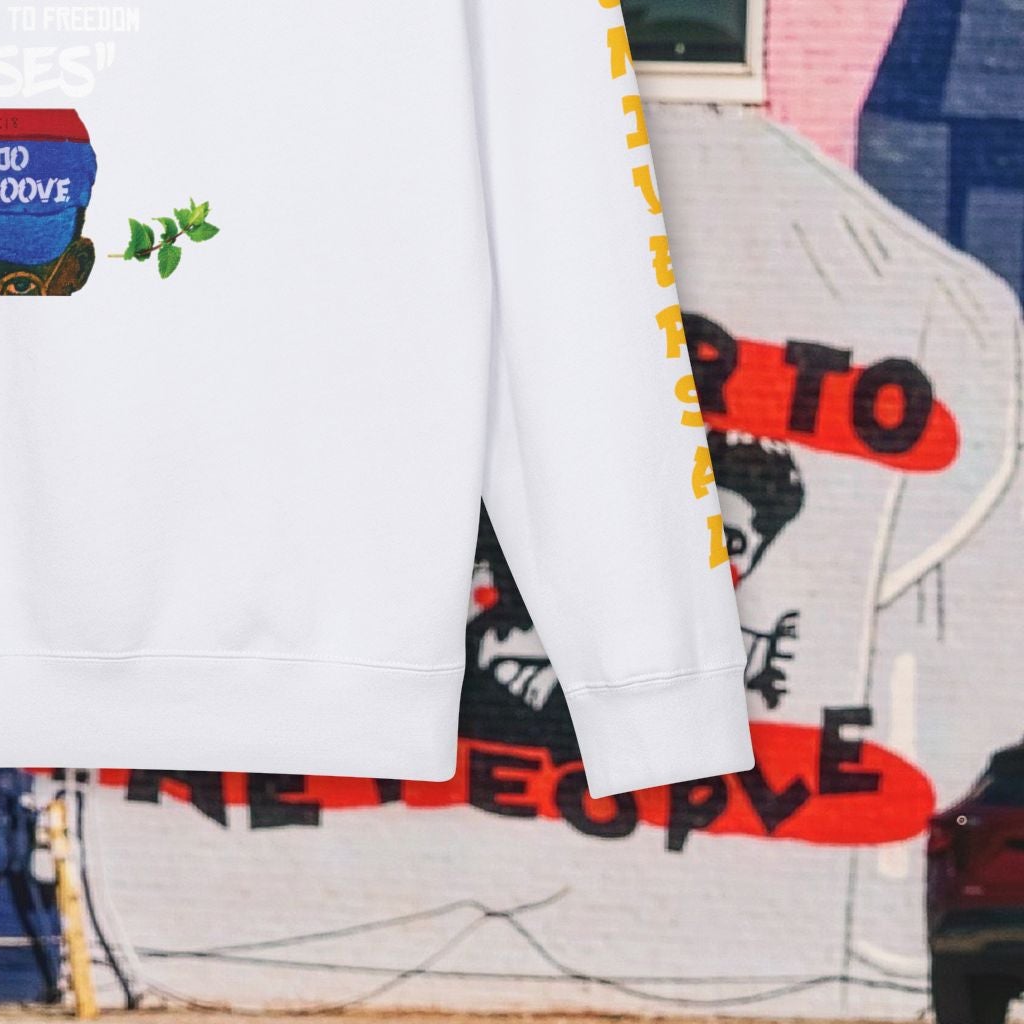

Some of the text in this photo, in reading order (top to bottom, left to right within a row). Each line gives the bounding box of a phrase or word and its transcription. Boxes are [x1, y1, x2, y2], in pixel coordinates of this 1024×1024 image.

[8, 6, 36, 32] TO
[43, 6, 140, 32] FREEDOM
[784, 339, 933, 454] TO
